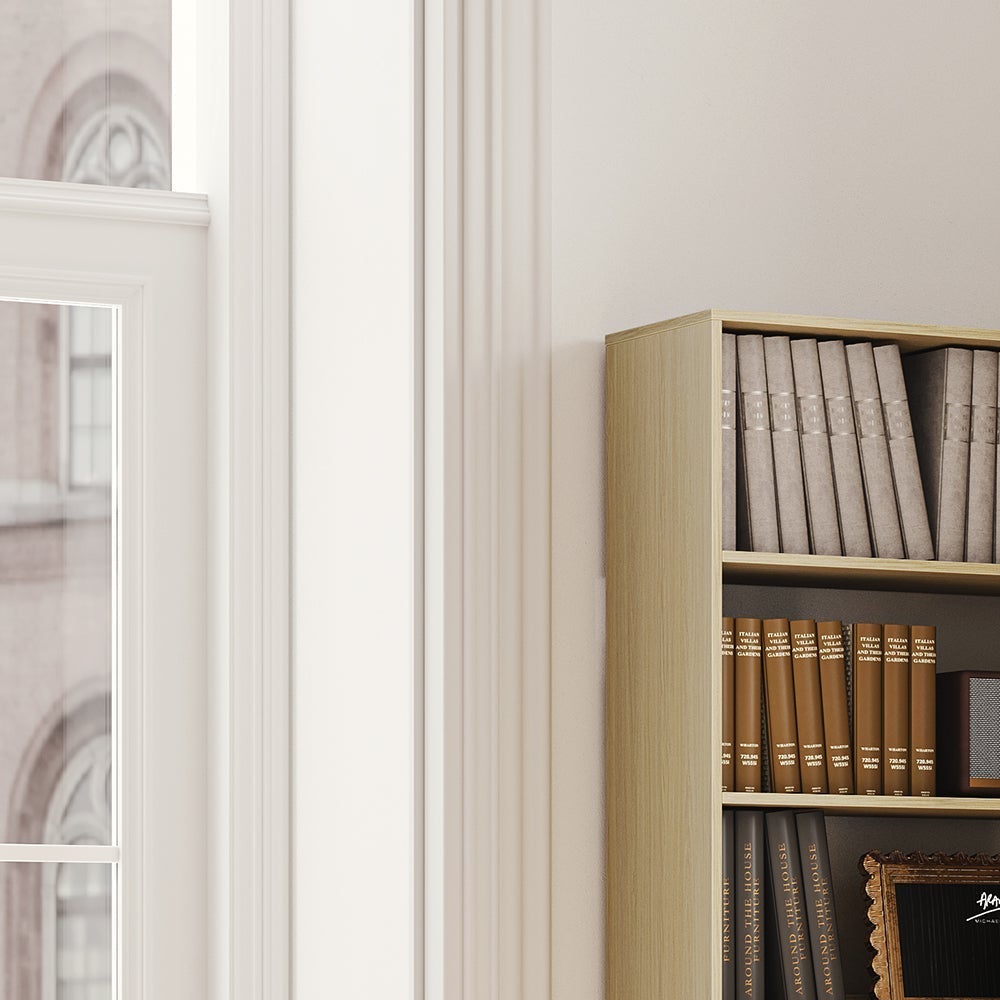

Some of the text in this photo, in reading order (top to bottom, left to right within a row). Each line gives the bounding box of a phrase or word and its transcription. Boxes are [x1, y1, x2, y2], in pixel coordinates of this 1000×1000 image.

[744, 841, 753, 997] AROUND THE HOUSE
[778, 842, 804, 995] AROUND THE HOUSE
[791, 877, 807, 960] FURNITURE
[808, 843, 834, 995] AROUND THE HOUSE
[822, 877, 837, 961] FURNITURE
